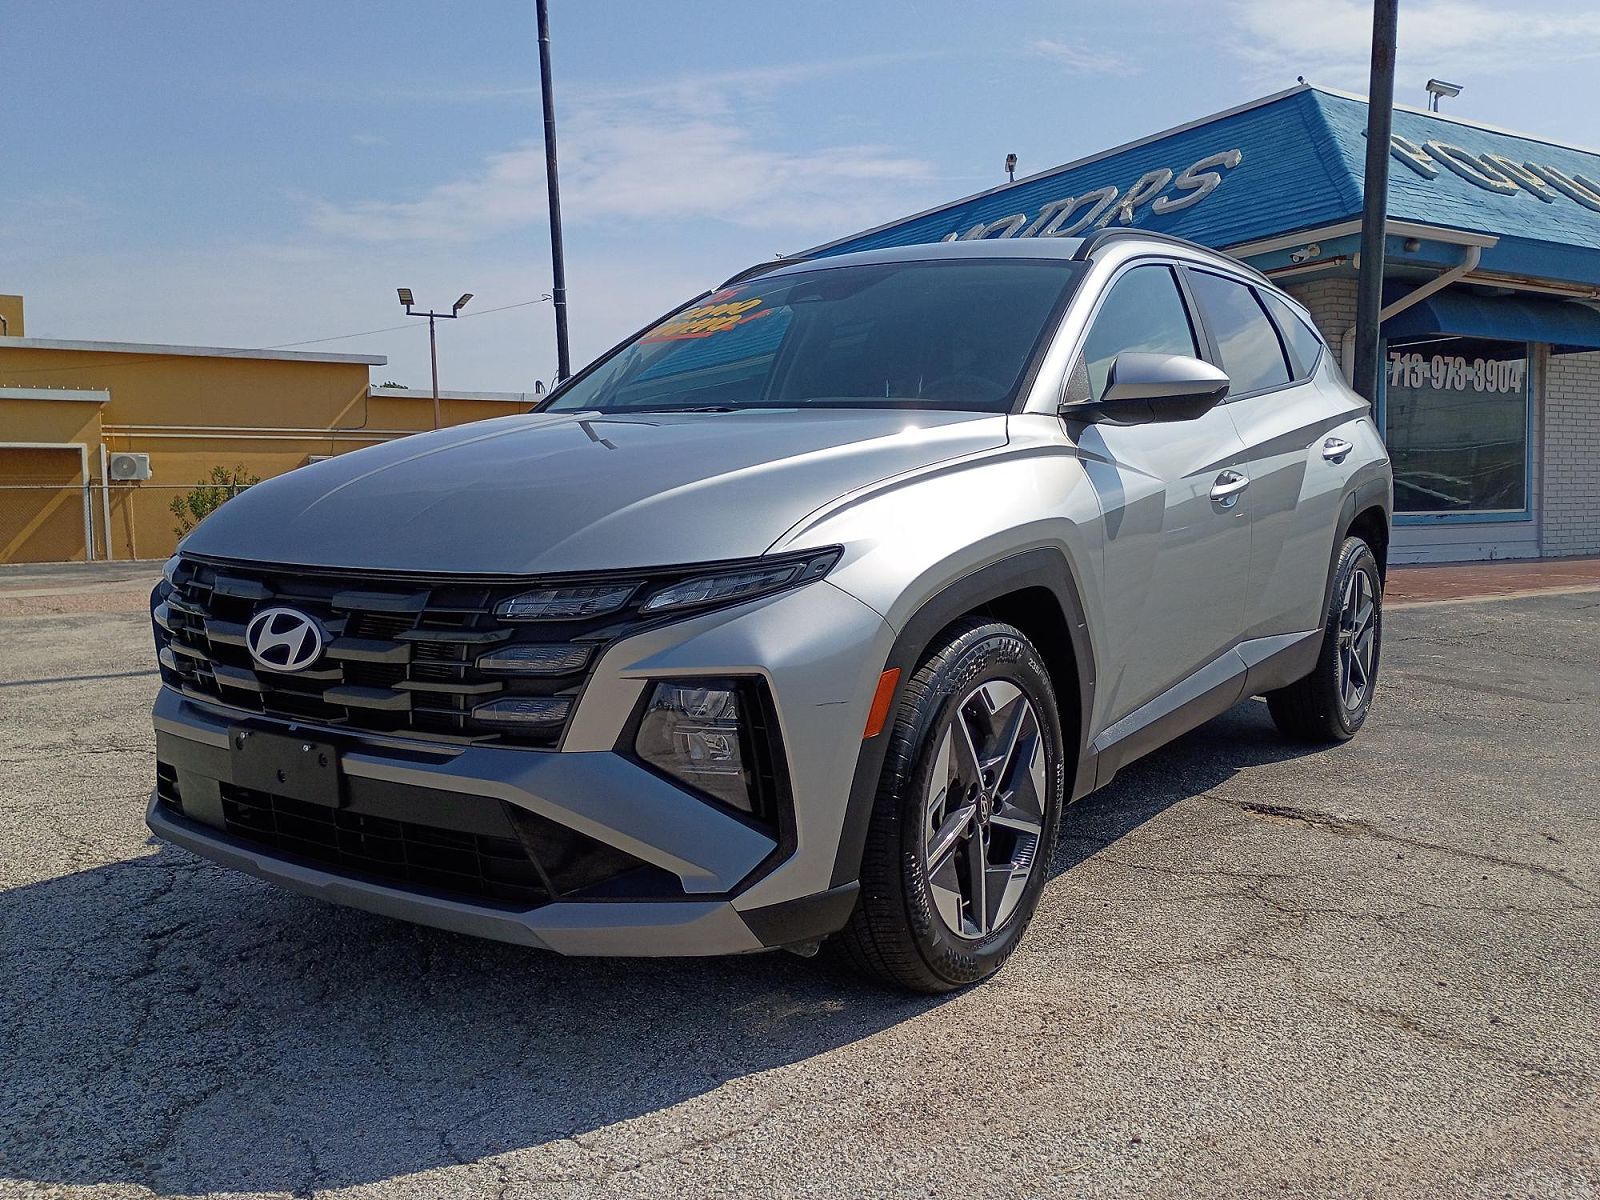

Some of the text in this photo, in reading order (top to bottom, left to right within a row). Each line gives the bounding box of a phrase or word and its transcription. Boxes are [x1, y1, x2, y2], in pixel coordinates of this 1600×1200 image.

[941, 149, 1242, 240] OTORS
[1361, 128, 1600, 213] POPU
[1389, 351, 1522, 394] 713-973-3904
